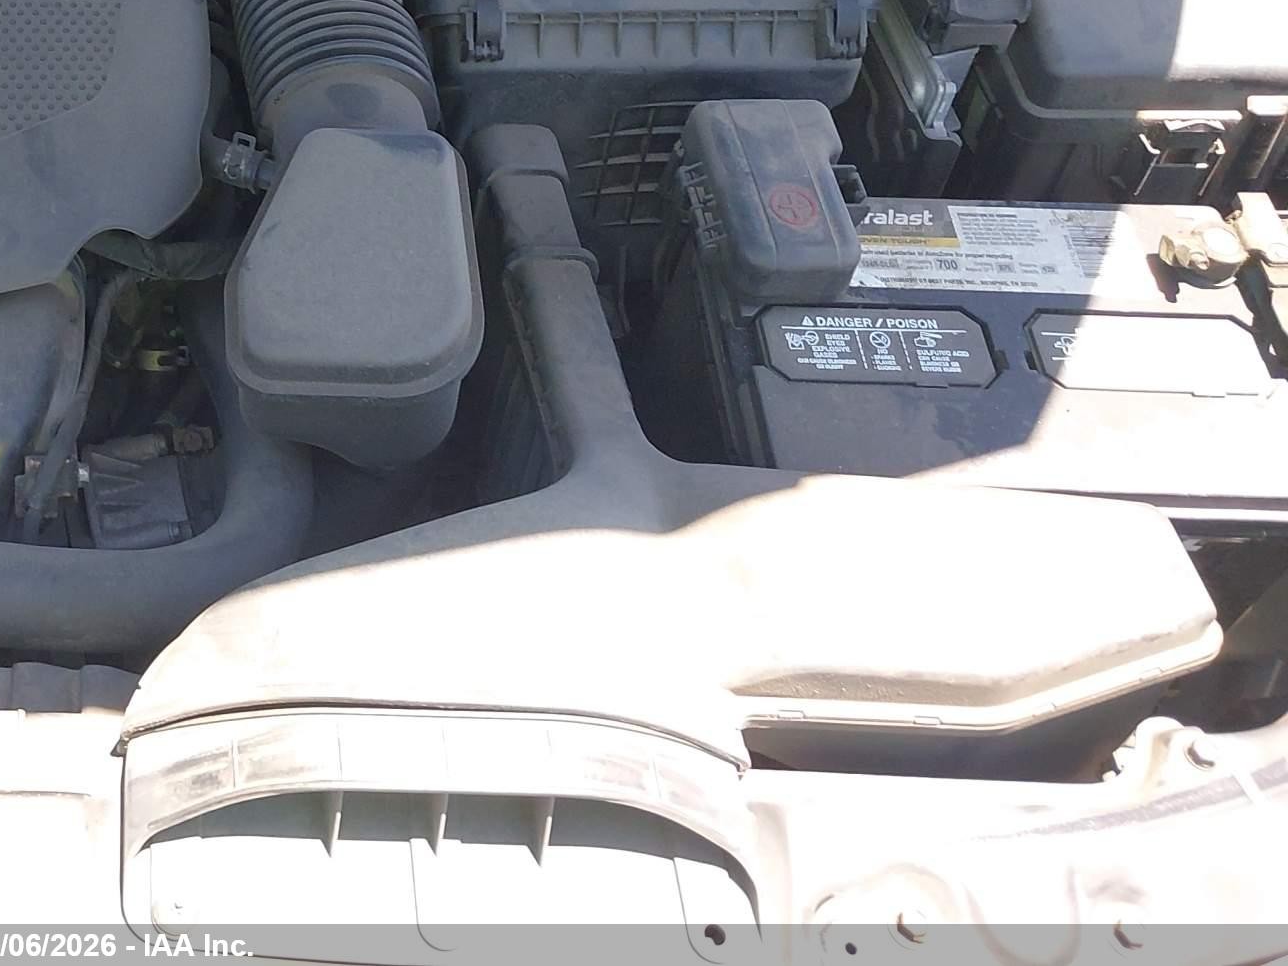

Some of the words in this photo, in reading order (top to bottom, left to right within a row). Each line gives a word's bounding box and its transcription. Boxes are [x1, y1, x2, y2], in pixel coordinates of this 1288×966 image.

[936, 260, 958, 270] 700
[816, 316, 873, 328] DANGER
[885, 318, 939, 329] POISON
[812, 345, 852, 353] EXPLOSIVE
